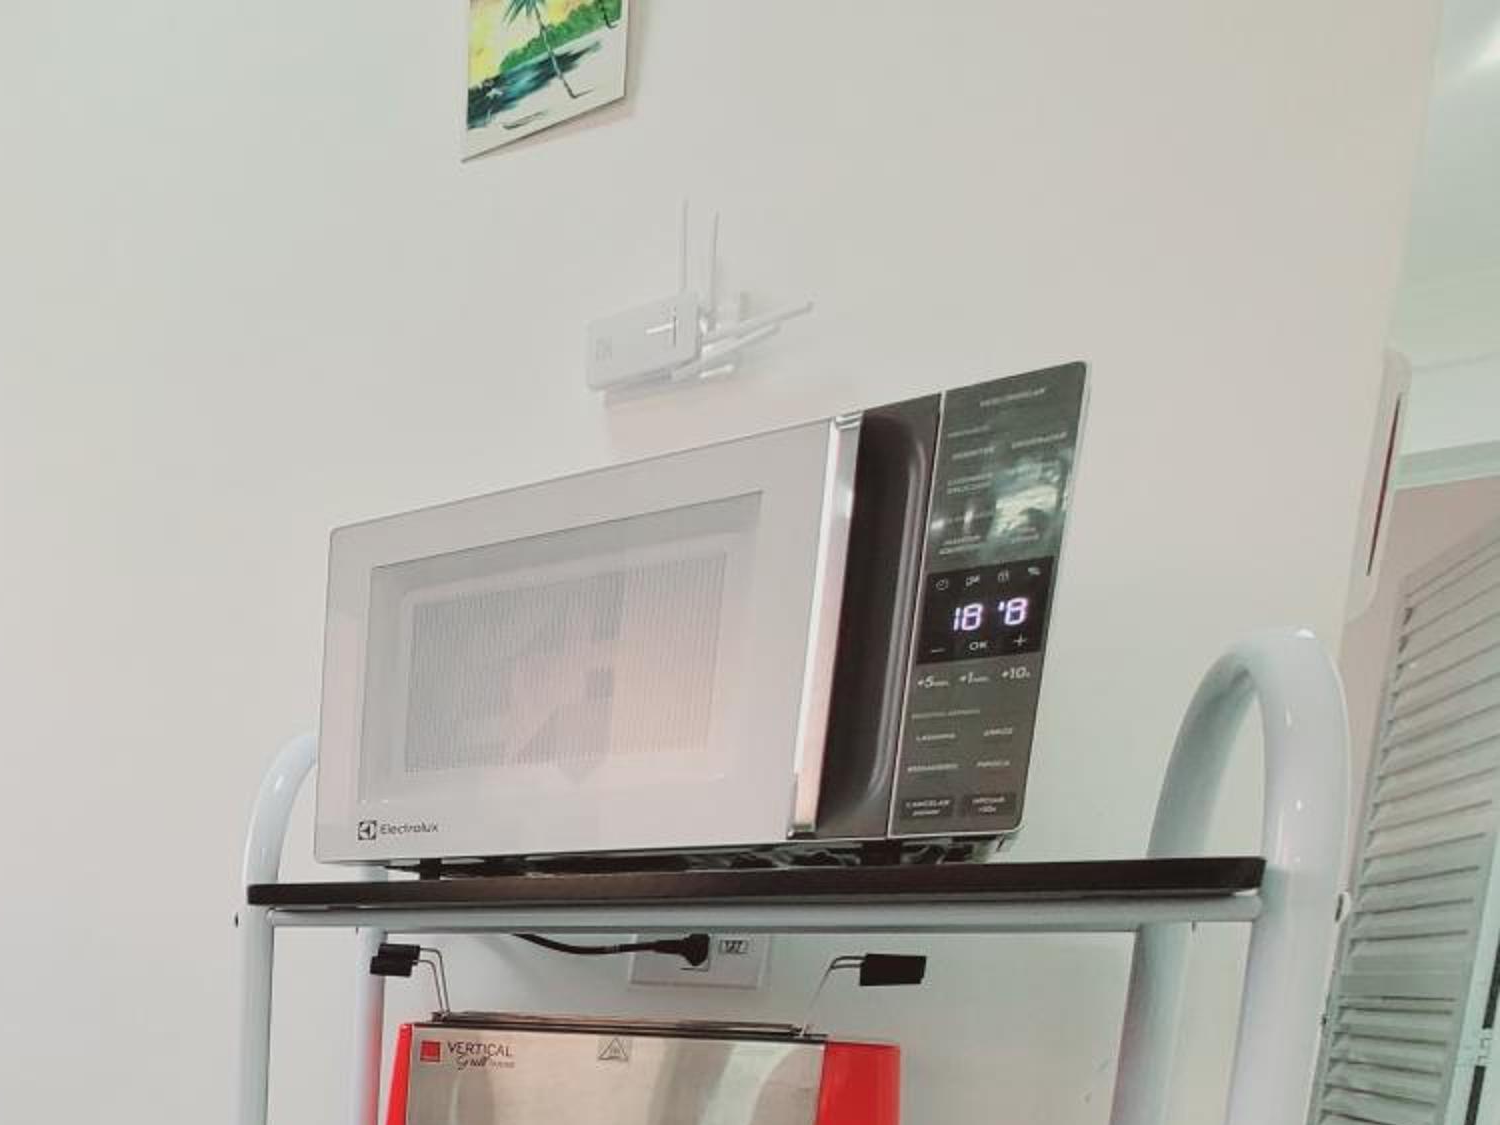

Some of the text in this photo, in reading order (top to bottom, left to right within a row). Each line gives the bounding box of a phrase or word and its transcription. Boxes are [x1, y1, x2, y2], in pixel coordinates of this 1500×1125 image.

[953, 603, 984, 631] 18
[379, 821, 440, 835] Electrolux
[446, 1040, 512, 1058] VERTICAL
